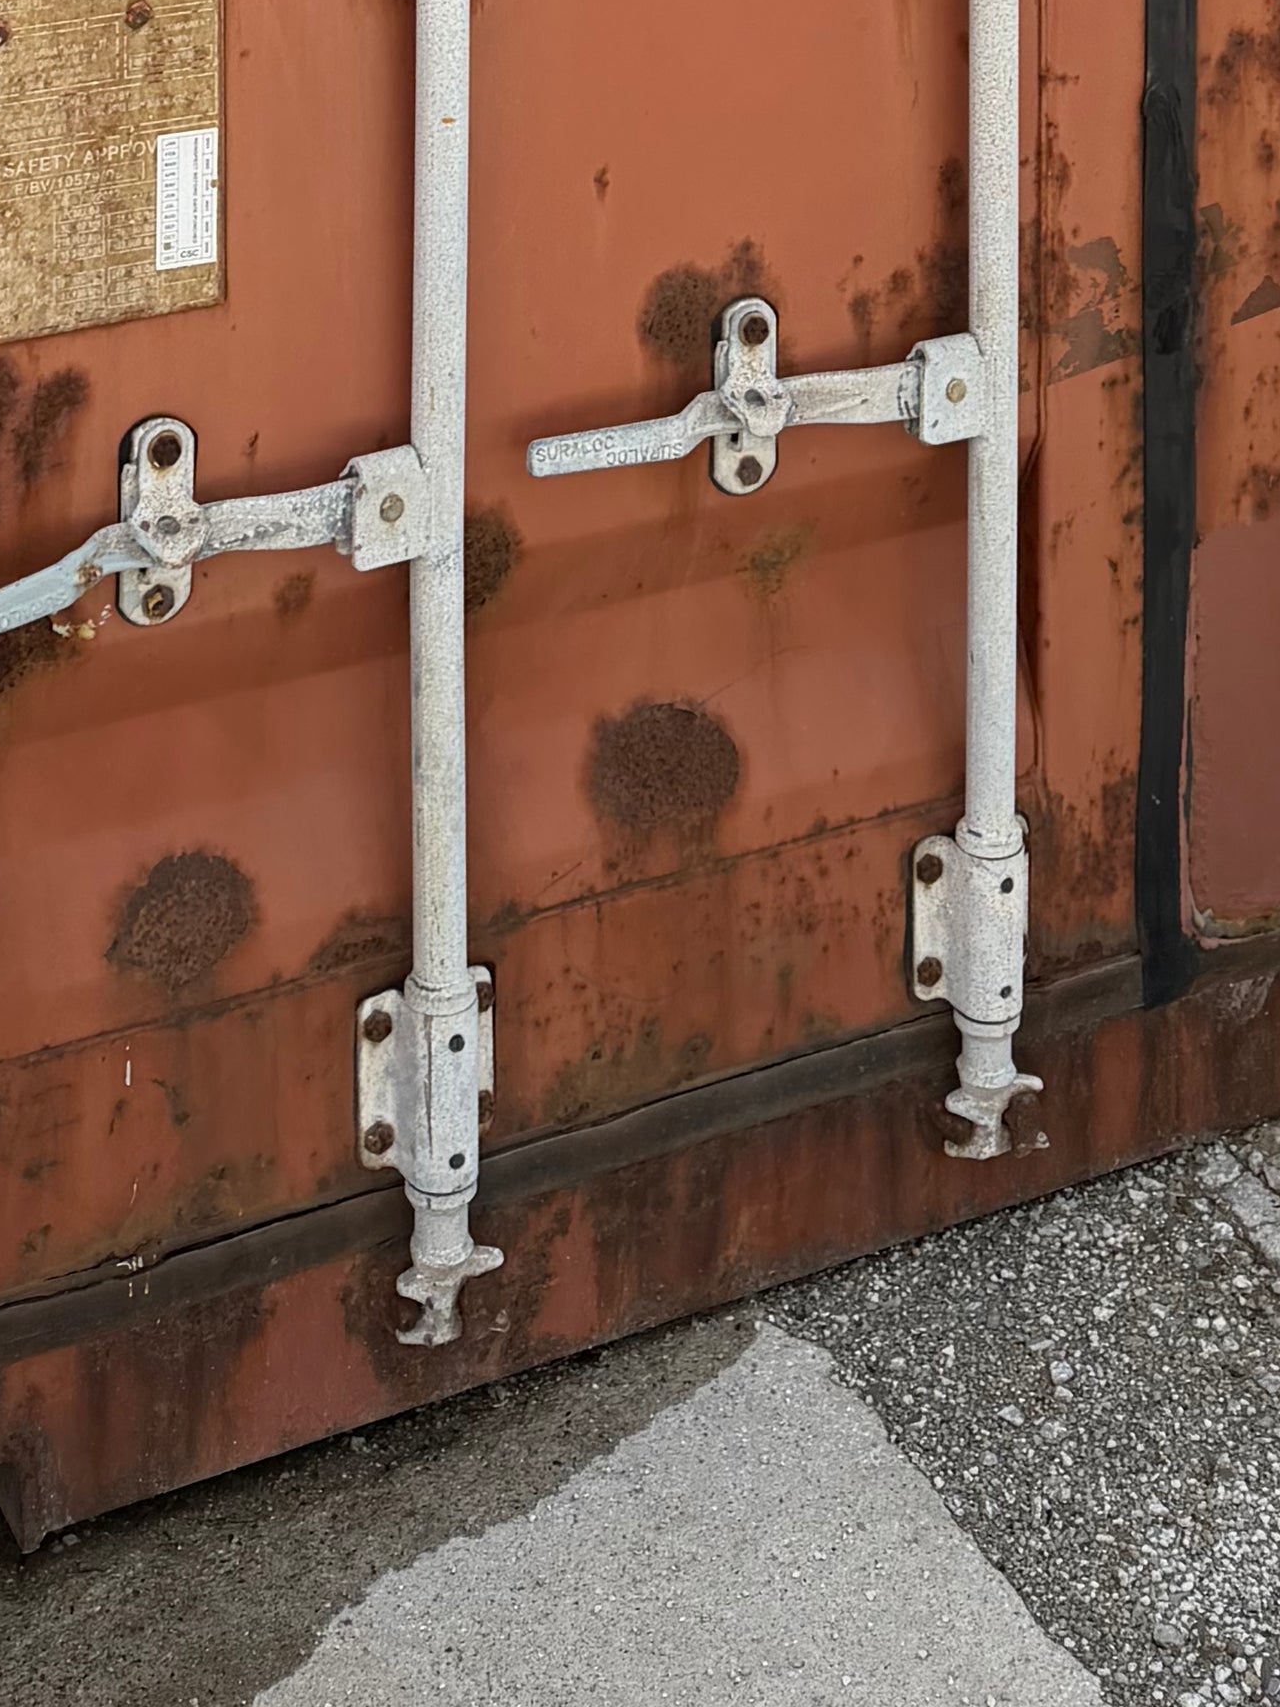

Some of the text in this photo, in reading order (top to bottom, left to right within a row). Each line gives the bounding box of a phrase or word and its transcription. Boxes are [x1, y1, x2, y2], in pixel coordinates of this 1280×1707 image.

[3, 151, 75, 179] SAFETY
[82, 139, 157, 166] APPROV
[180, 249, 200, 259] CSC
